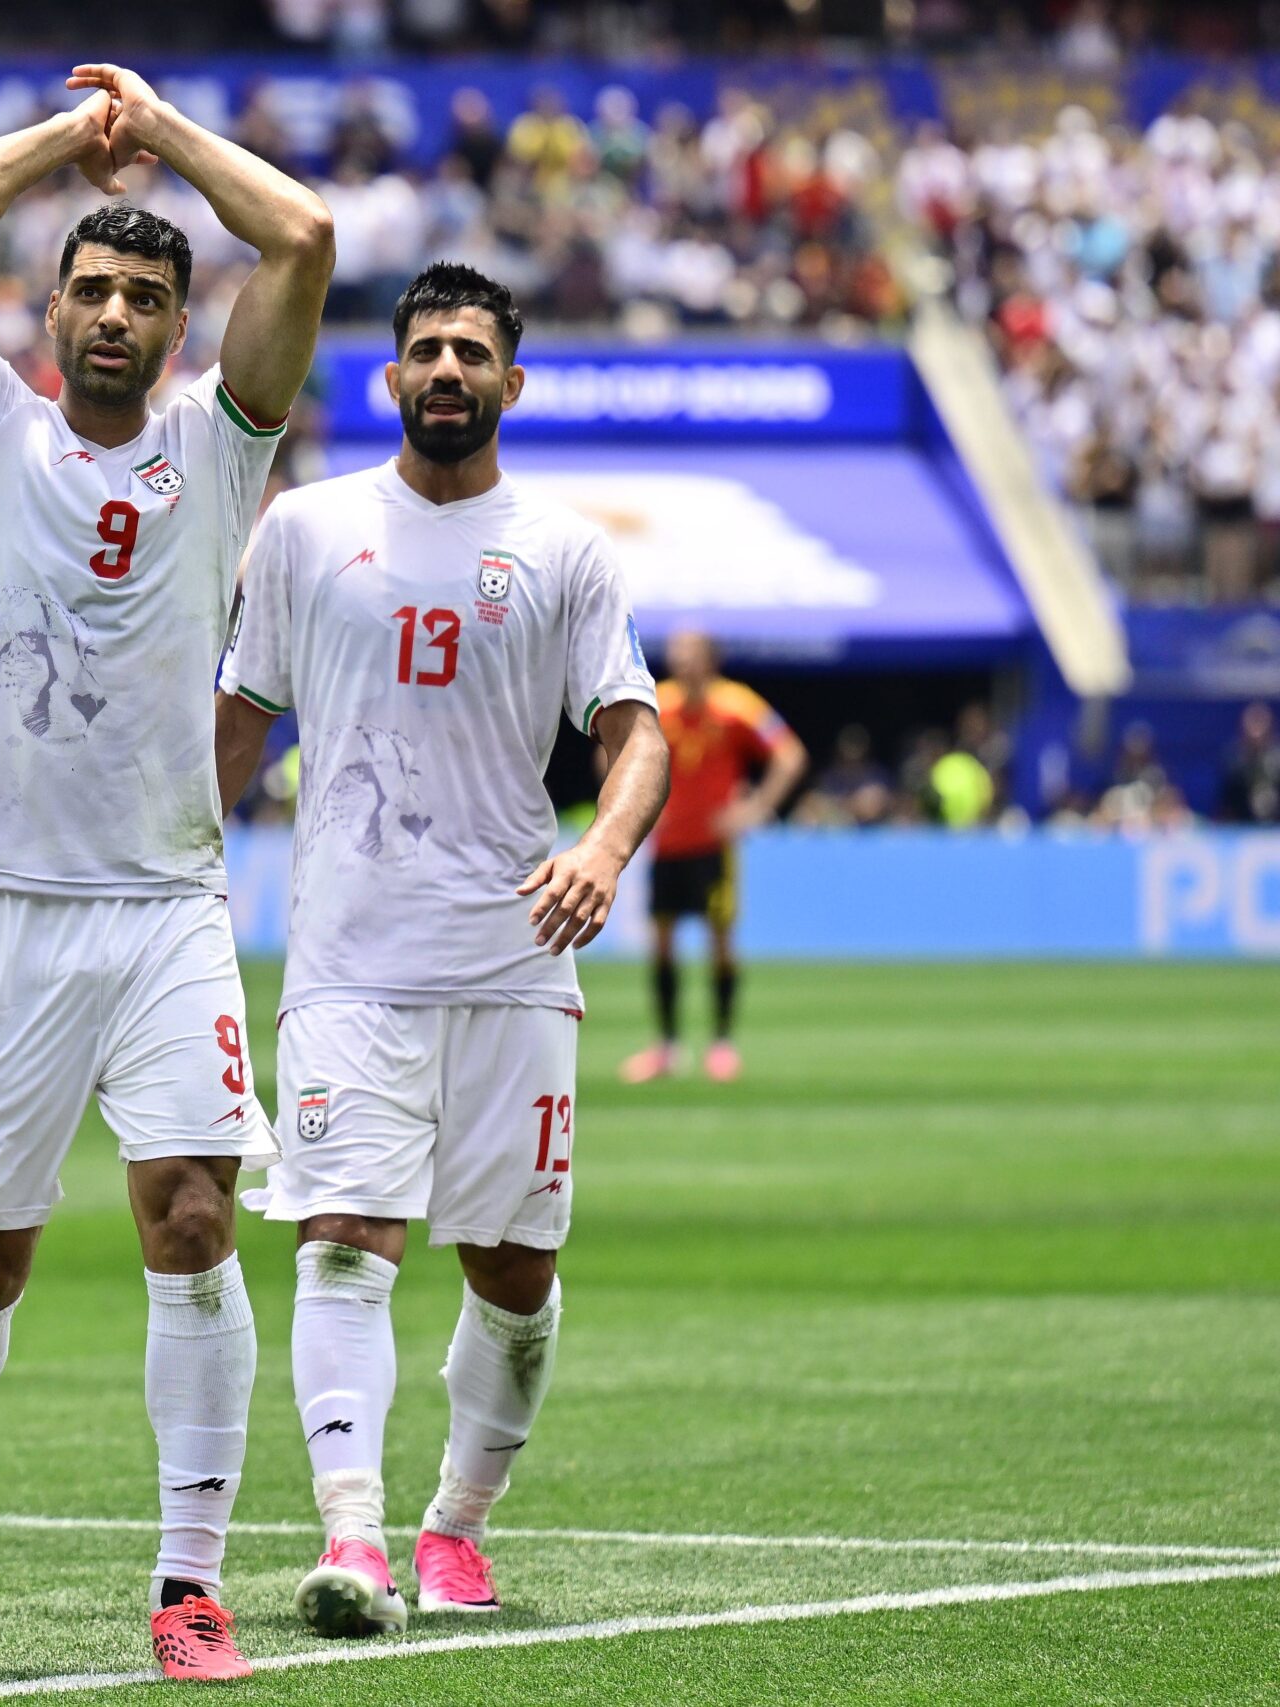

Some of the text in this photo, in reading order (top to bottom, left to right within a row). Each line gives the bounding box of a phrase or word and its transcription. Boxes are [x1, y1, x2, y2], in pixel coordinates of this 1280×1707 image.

[89, 500, 140, 579] 9
[391, 606, 461, 687] 13
[215, 1015, 245, 1095] 9
[532, 1095, 570, 1172] 13
